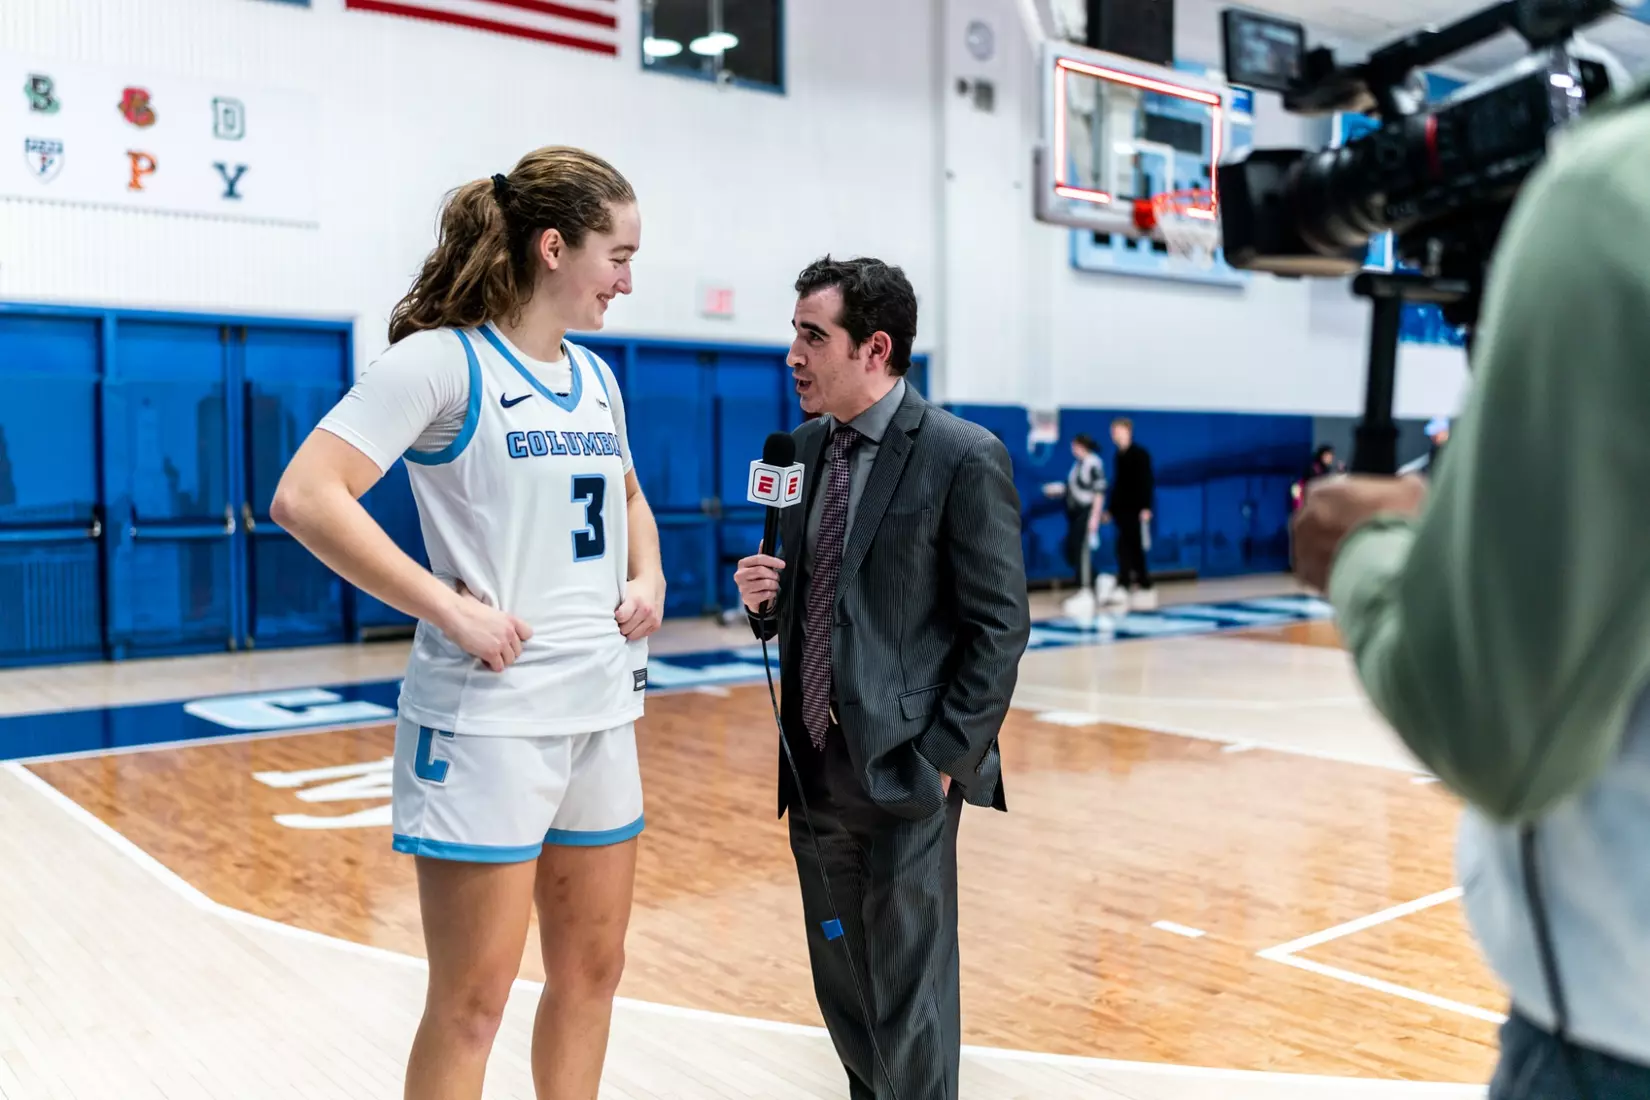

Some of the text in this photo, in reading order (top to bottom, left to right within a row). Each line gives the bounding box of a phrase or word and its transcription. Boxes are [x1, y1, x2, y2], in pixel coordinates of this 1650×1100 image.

[211, 96, 246, 141] D
[125, 150, 157, 191] P
[211, 161, 250, 200] Y
[507, 430, 622, 459] COLUMBI
[758, 475, 775, 494] E
[570, 473, 607, 562] 3
